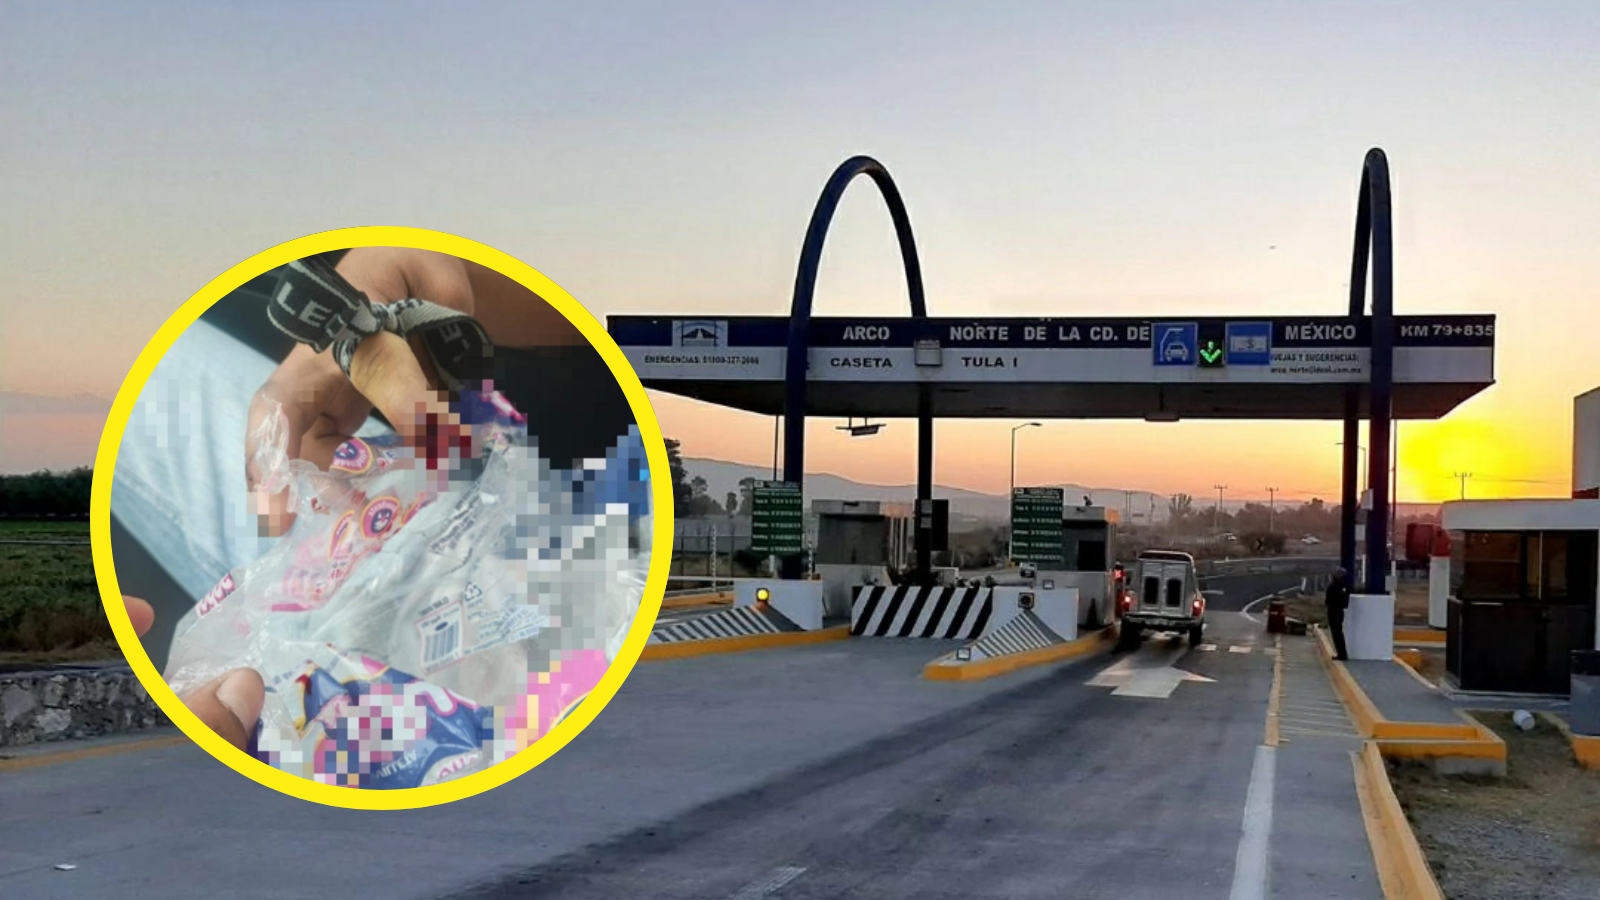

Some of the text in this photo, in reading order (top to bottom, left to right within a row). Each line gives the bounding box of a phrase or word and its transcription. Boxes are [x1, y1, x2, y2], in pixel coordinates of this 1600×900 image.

[842, 325, 890, 341] ARCO
[949, 325, 1009, 341] NORTE
[1024, 326, 1047, 341] DE
[1058, 326, 1081, 341] LA
[1089, 326, 1118, 341] CD.
[1126, 326, 1150, 341] DE
[1400, 325, 1429, 337] KM
[830, 358, 893, 368] CASETA
[961, 357, 1005, 367] TULA
